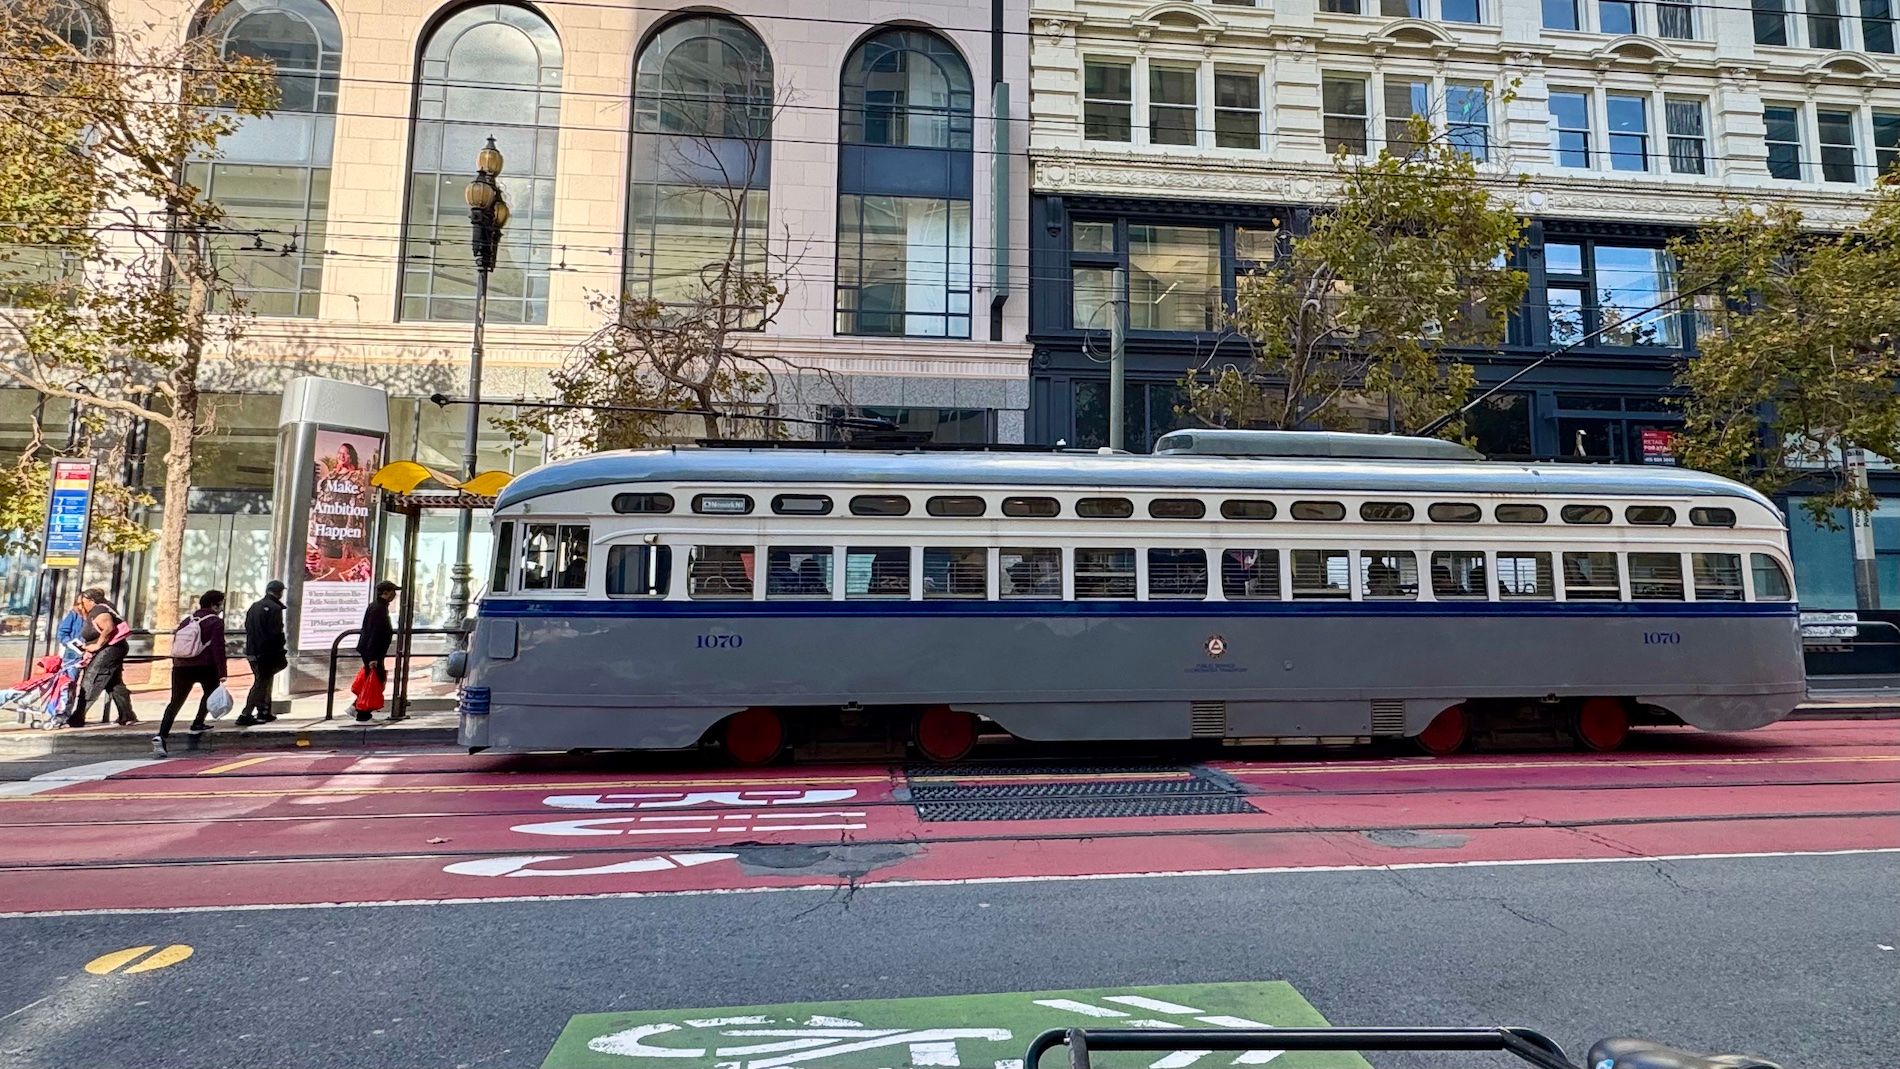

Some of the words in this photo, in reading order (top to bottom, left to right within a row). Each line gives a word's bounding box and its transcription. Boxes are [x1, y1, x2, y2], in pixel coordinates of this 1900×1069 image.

[325, 480, 359, 494] Make
[313, 501, 369, 517] Ambition
[315, 523, 361, 540] Happen
[695, 634, 743, 648] 1070
[1643, 632, 1680, 644] 1070
